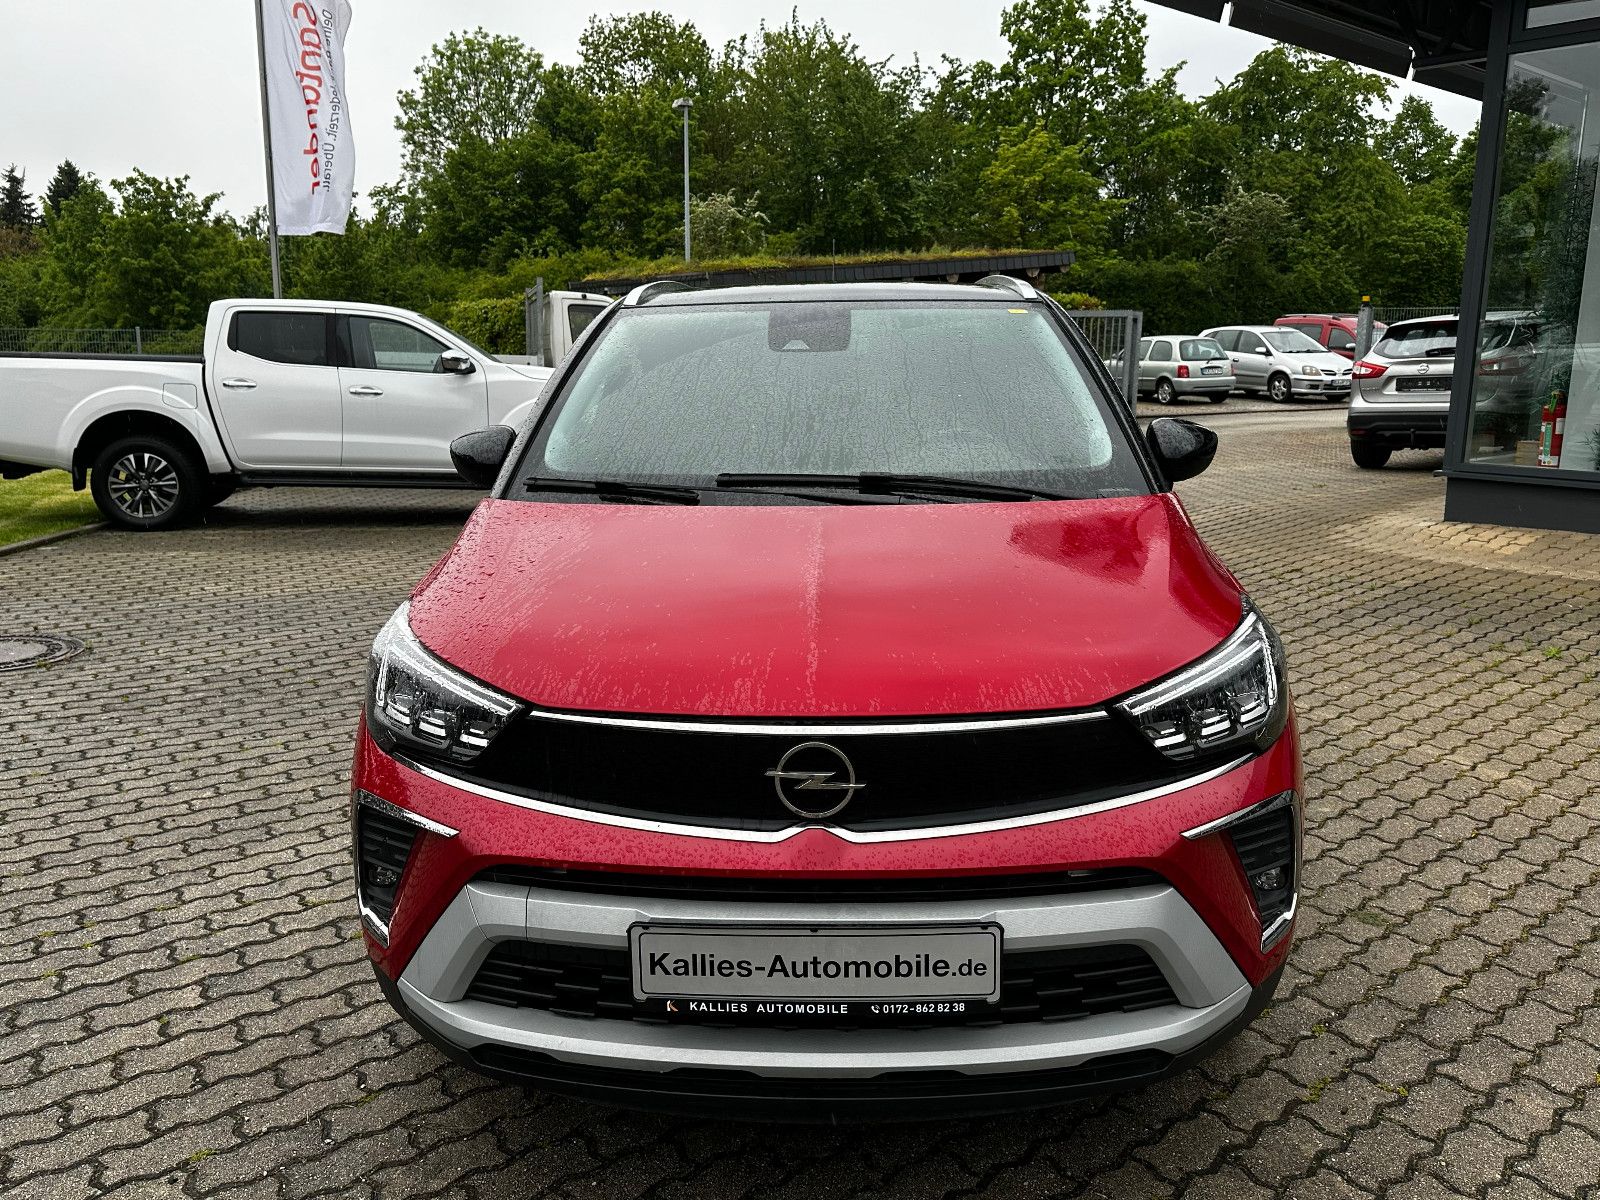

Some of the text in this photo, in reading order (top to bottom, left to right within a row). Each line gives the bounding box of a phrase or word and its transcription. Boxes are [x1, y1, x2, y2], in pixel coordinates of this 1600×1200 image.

[649, 952, 988, 979] Kallies-Automobile.de
[689, 1001, 748, 1013] KALLIES
[756, 1003, 849, 1014] AUTOMOBILE
